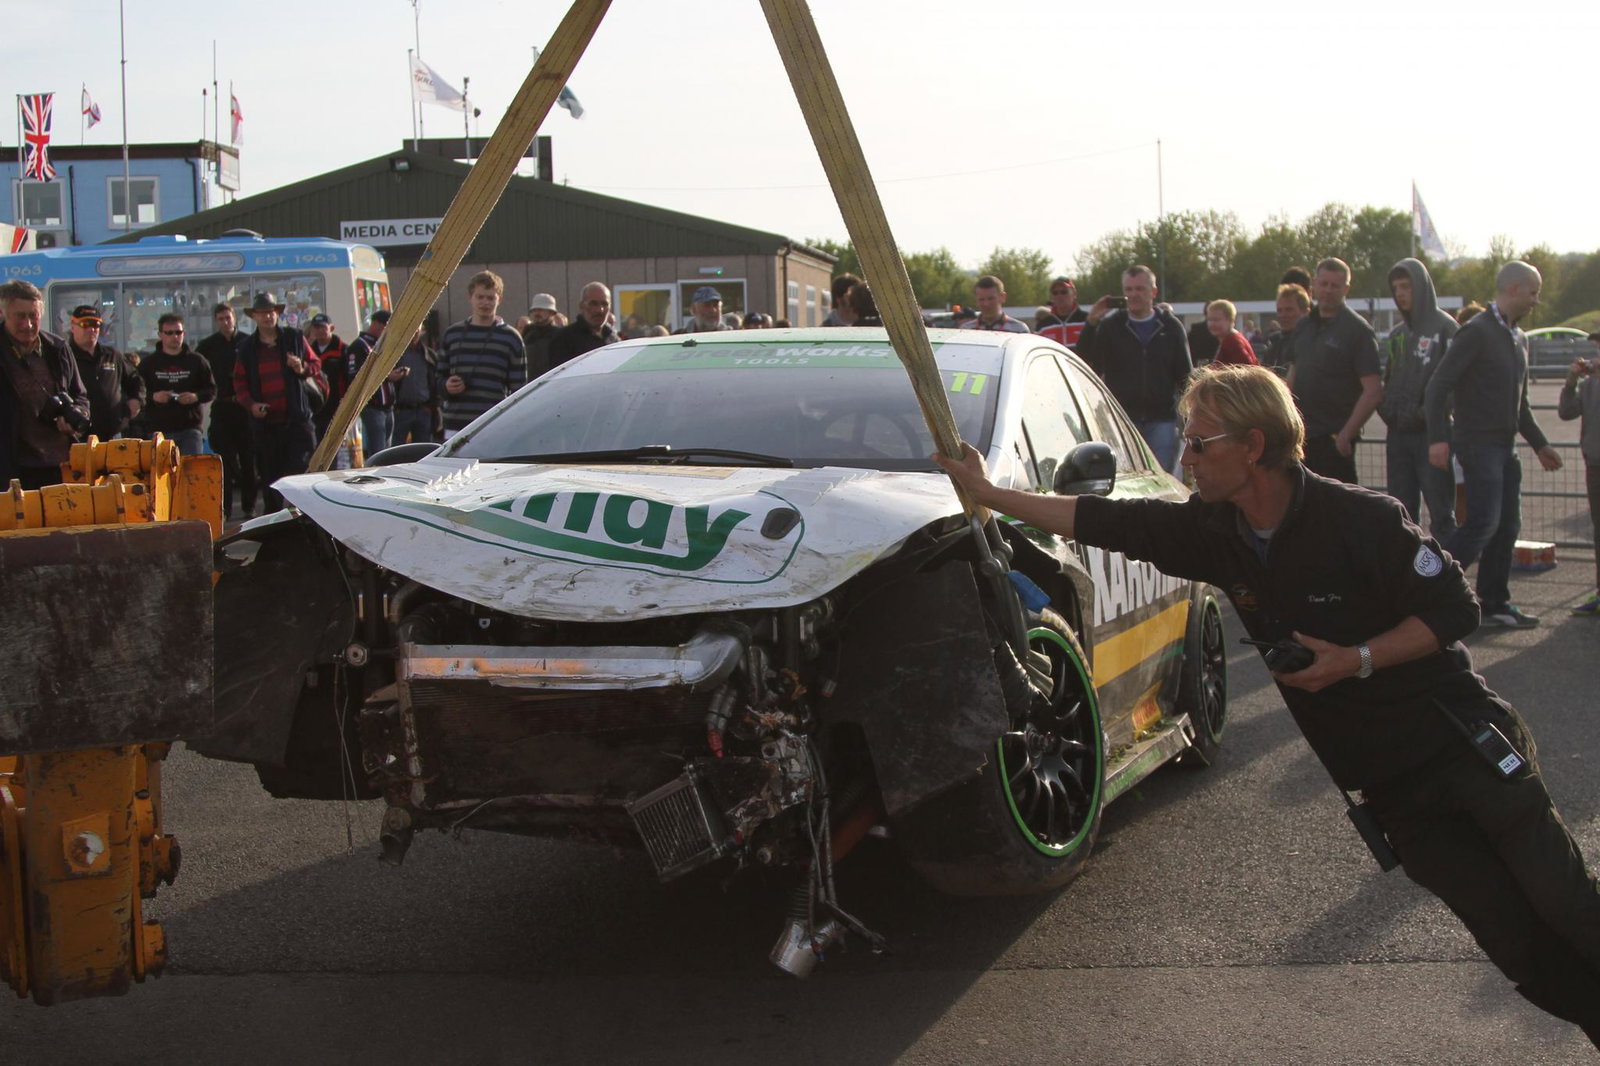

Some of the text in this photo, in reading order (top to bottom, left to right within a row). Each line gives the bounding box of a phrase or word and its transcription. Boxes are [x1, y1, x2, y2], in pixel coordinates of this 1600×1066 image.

[343, 225, 398, 239] MEDIA
[255, 253, 338, 265] EST 1963
[4, 264, 42, 277] 1963
[670, 345, 890, 362] greenworks
[734, 357, 810, 366] TOOLS
[950, 371, 988, 395] 11
